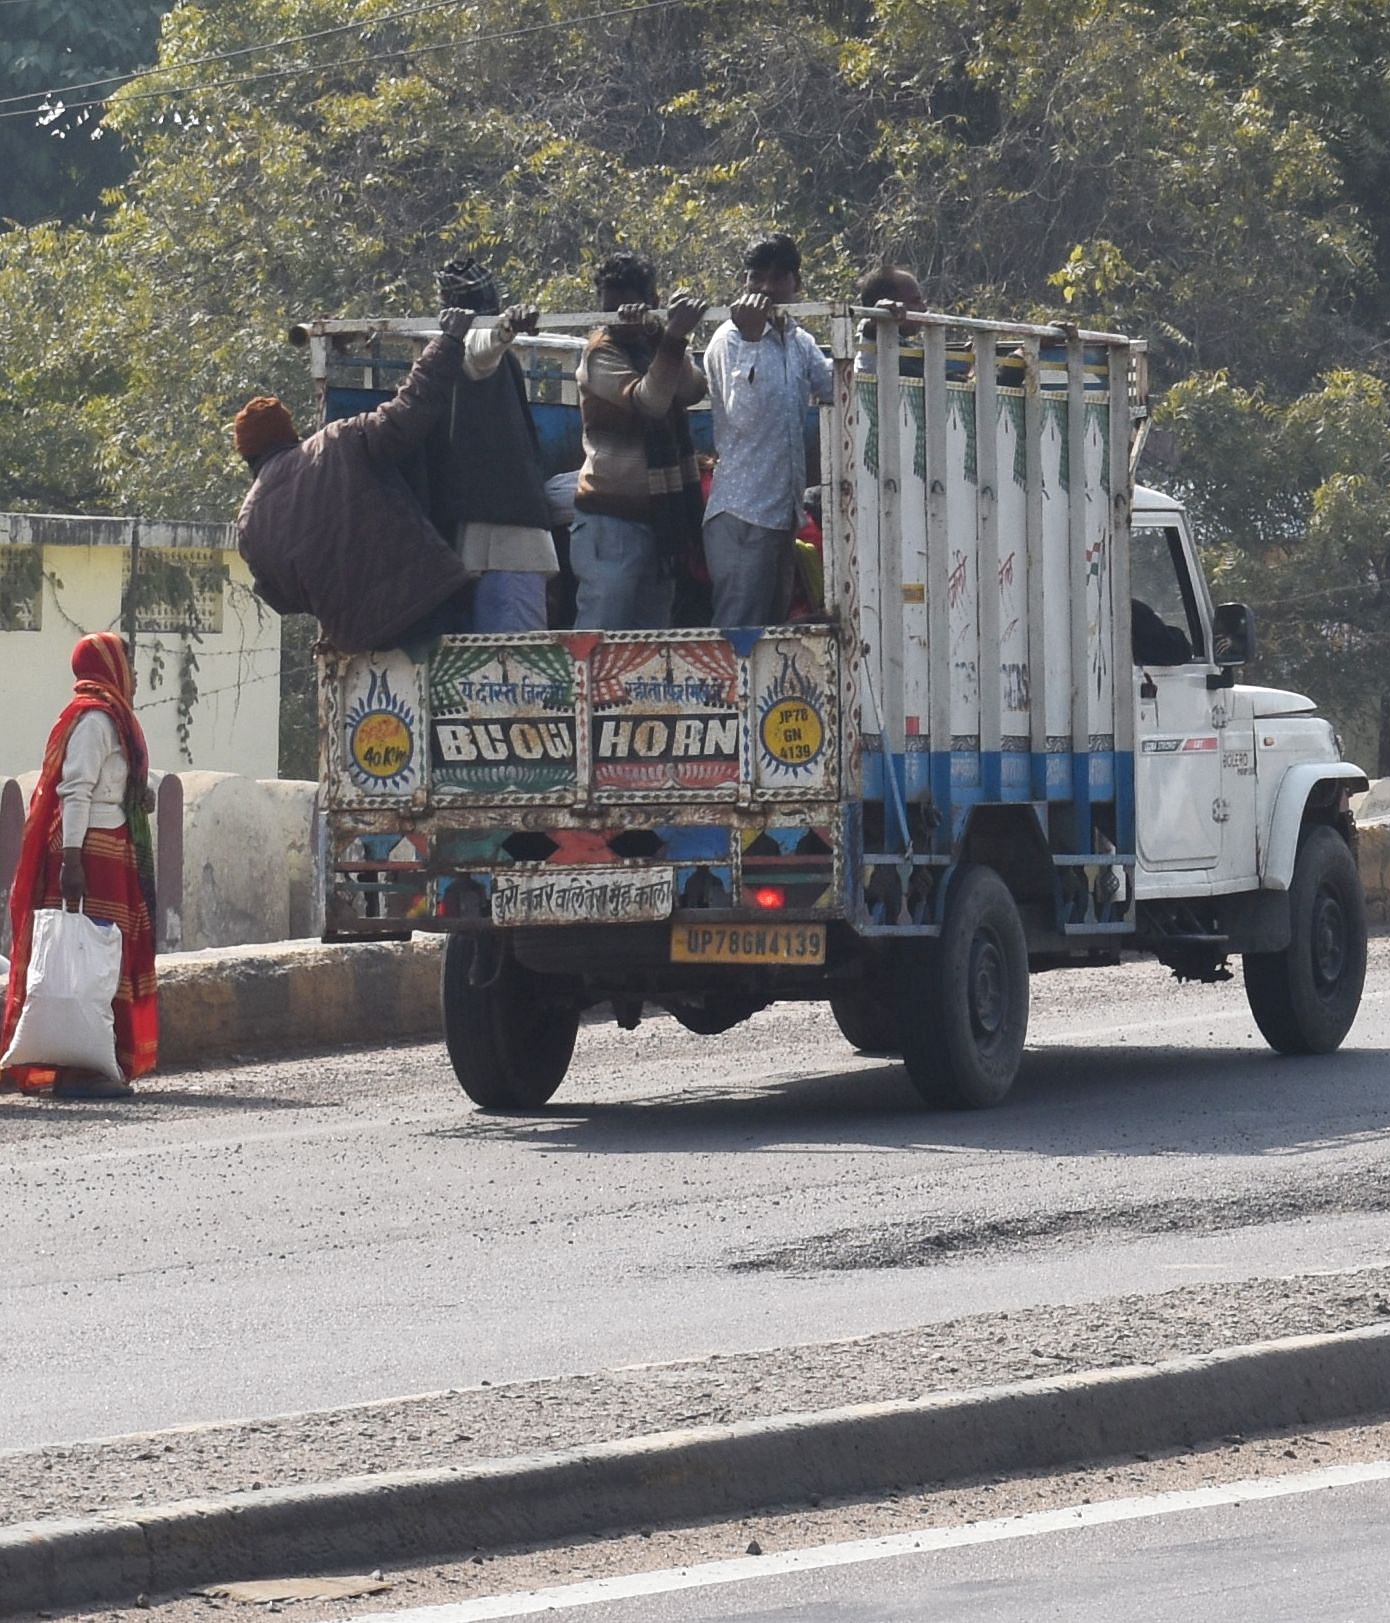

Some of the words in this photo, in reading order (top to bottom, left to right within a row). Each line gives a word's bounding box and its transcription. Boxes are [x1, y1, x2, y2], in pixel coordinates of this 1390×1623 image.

[598, 719, 738, 757] HORN
[783, 727, 802, 743] GN
[781, 744, 811, 760] 4139
[687, 930, 821, 957] UP78GN4139
